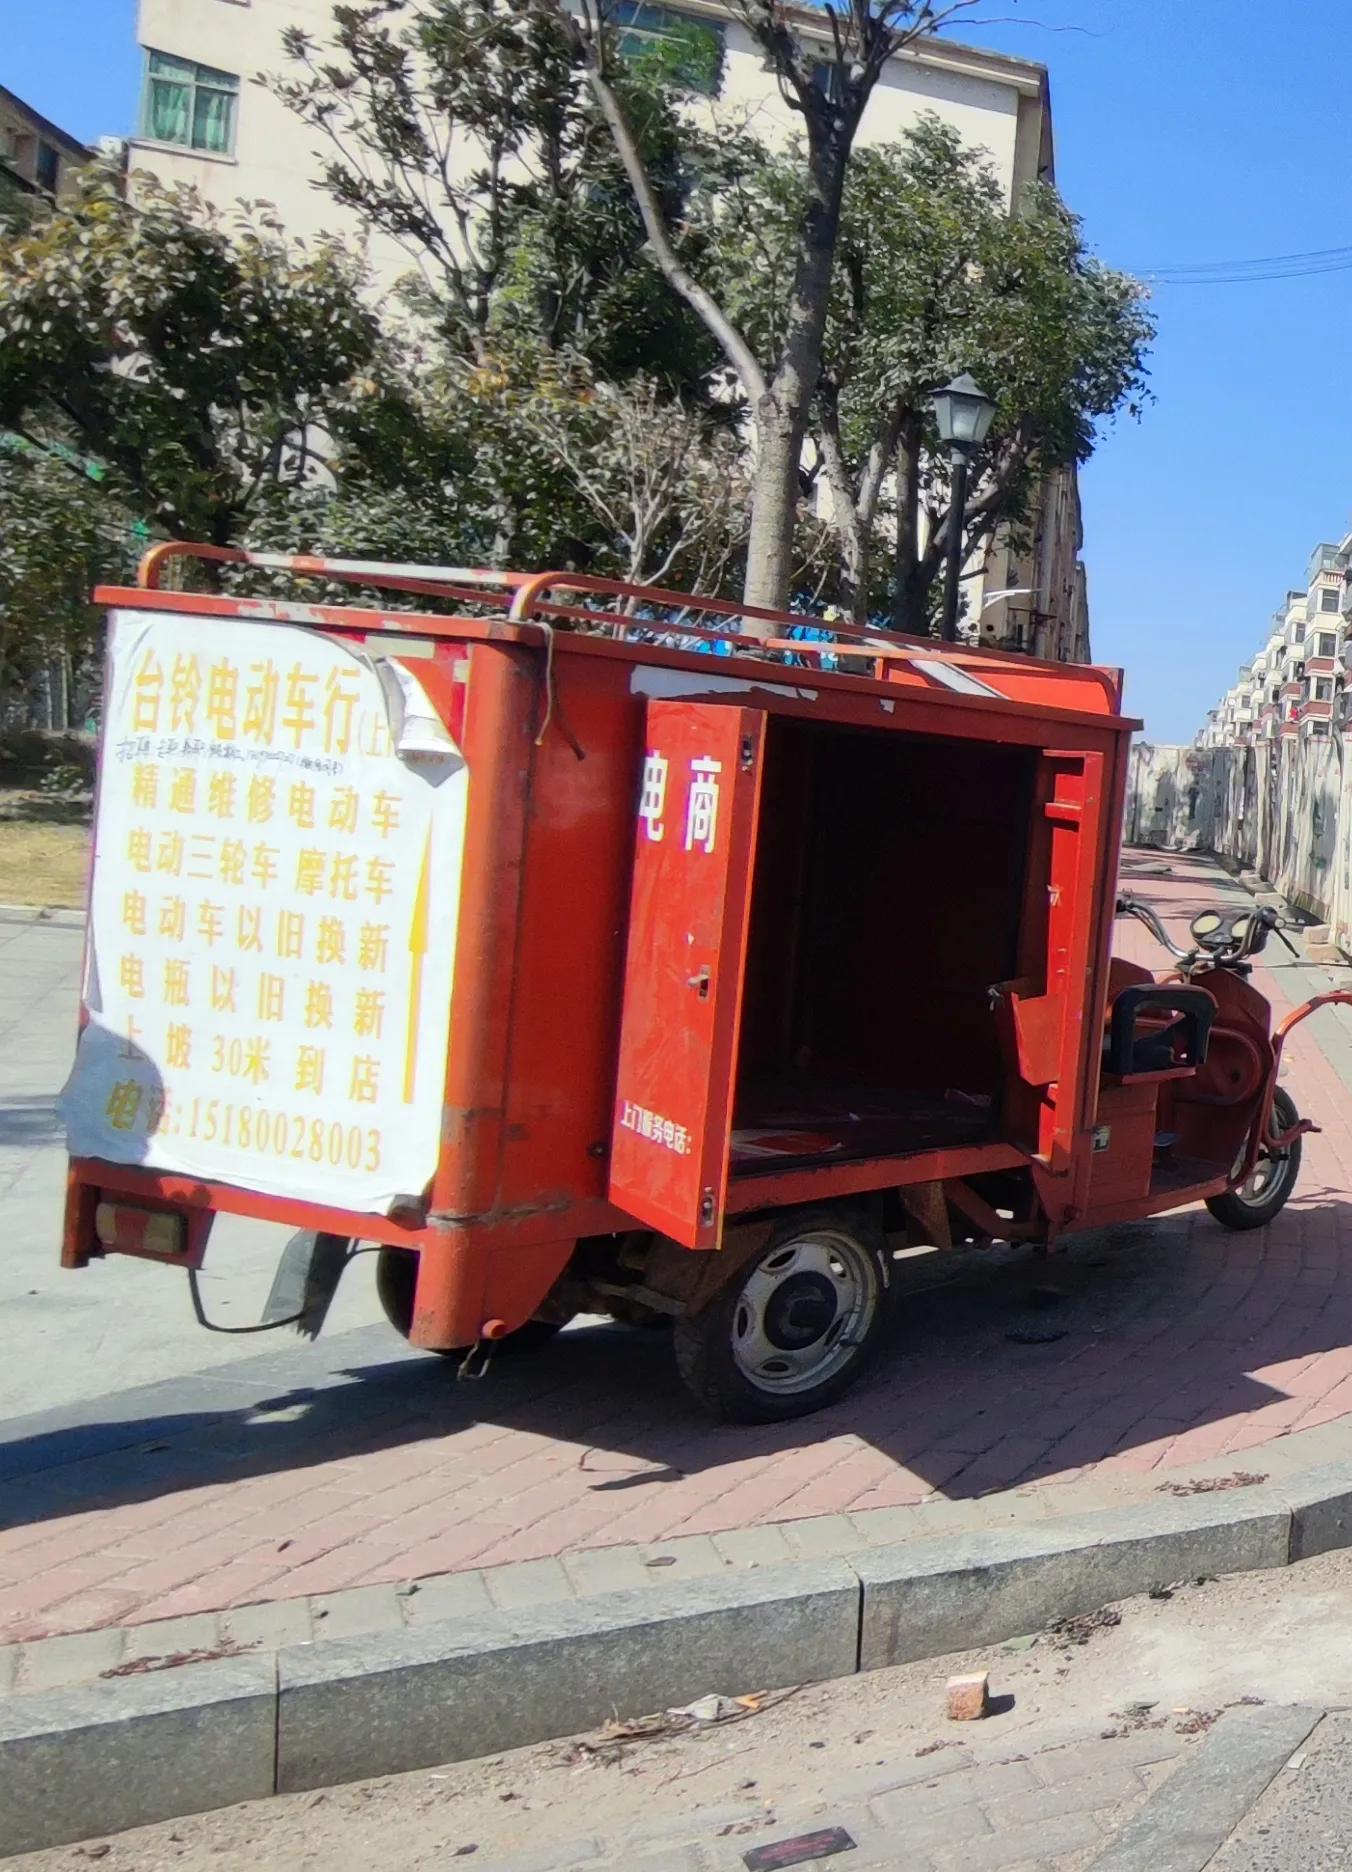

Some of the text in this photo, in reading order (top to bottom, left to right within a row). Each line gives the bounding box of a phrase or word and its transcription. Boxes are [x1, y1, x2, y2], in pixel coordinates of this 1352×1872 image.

[133, 648, 361, 757] 台铃电动车行
[131, 763, 402, 839] 精通维修电动车
[640, 749, 722, 854] 电商
[126, 827, 396, 904] 电动三轮车 摩托车
[122, 889, 391, 973] 电动车以旧换新
[119, 952, 386, 1040] 电瓶以旧换新
[117, 1013, 382, 1105] 上坡30米到店
[105, 1077, 382, 1173] 电话:15180028003
[620, 1099, 692, 1155] 上门服务电话:
